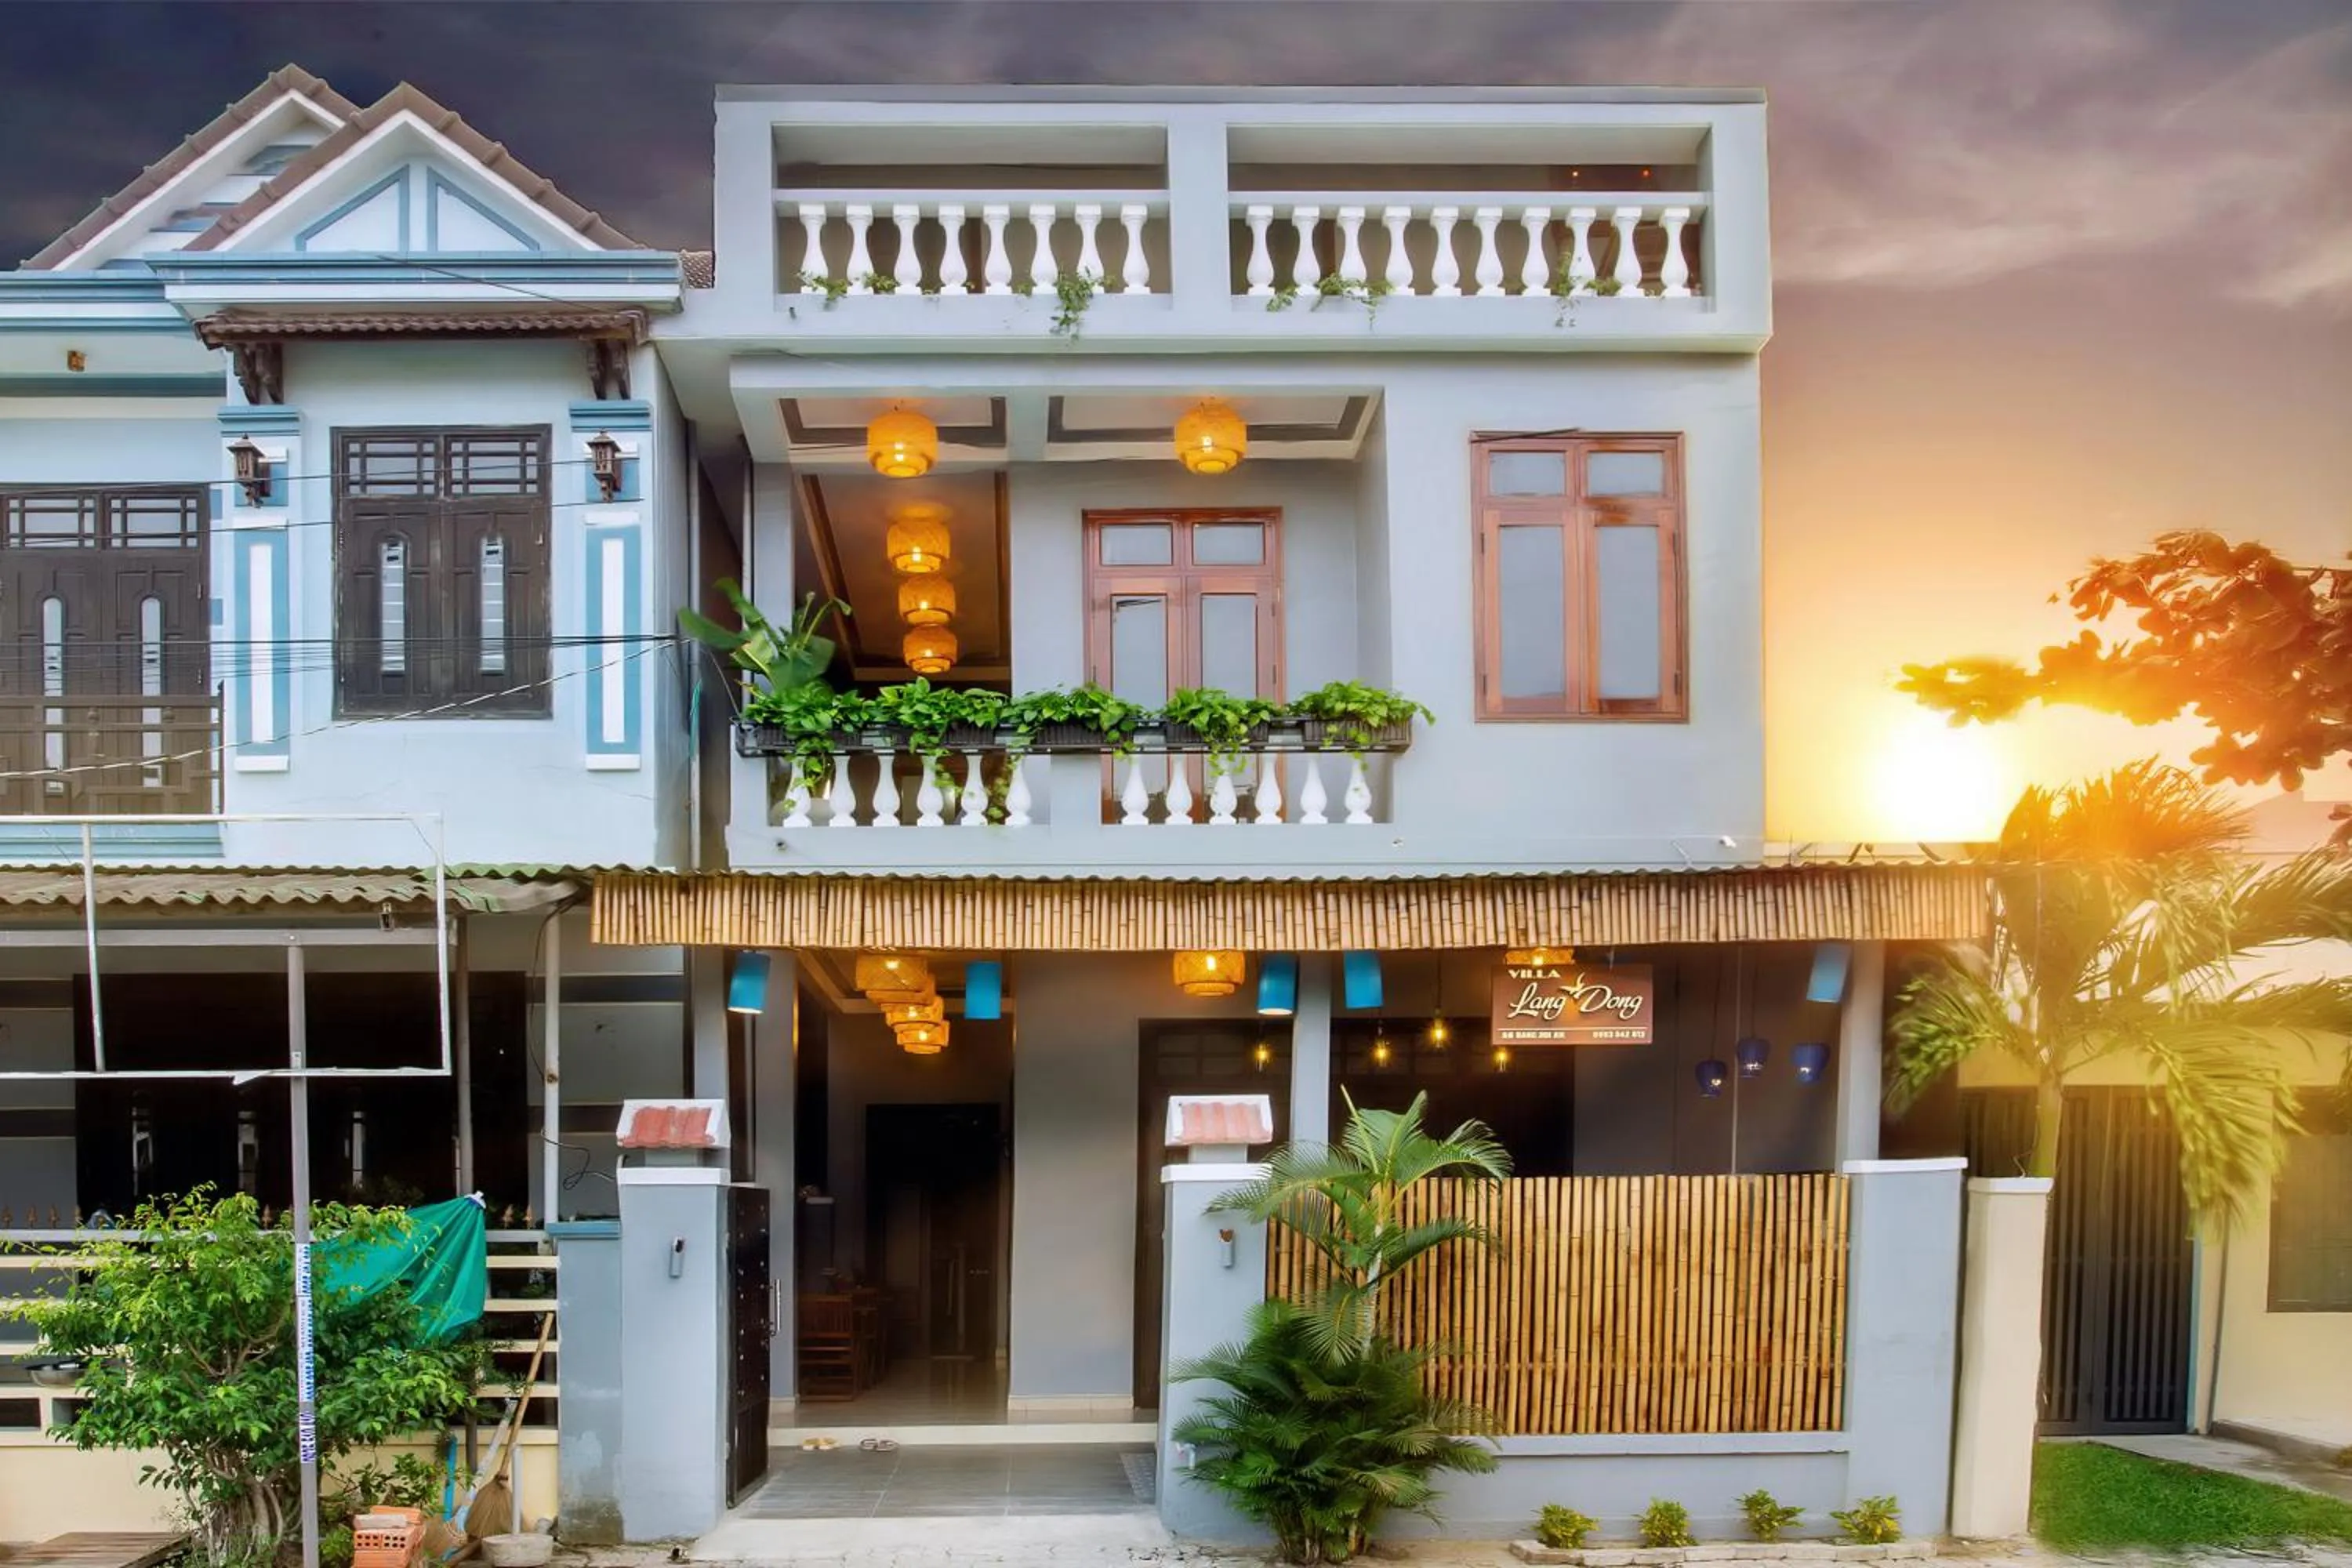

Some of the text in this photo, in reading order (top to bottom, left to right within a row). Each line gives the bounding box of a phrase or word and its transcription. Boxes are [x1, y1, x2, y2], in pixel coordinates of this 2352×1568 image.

[1508, 968, 1561, 979] VILLA
[1506, 982, 1644, 1021] Lang Dong
